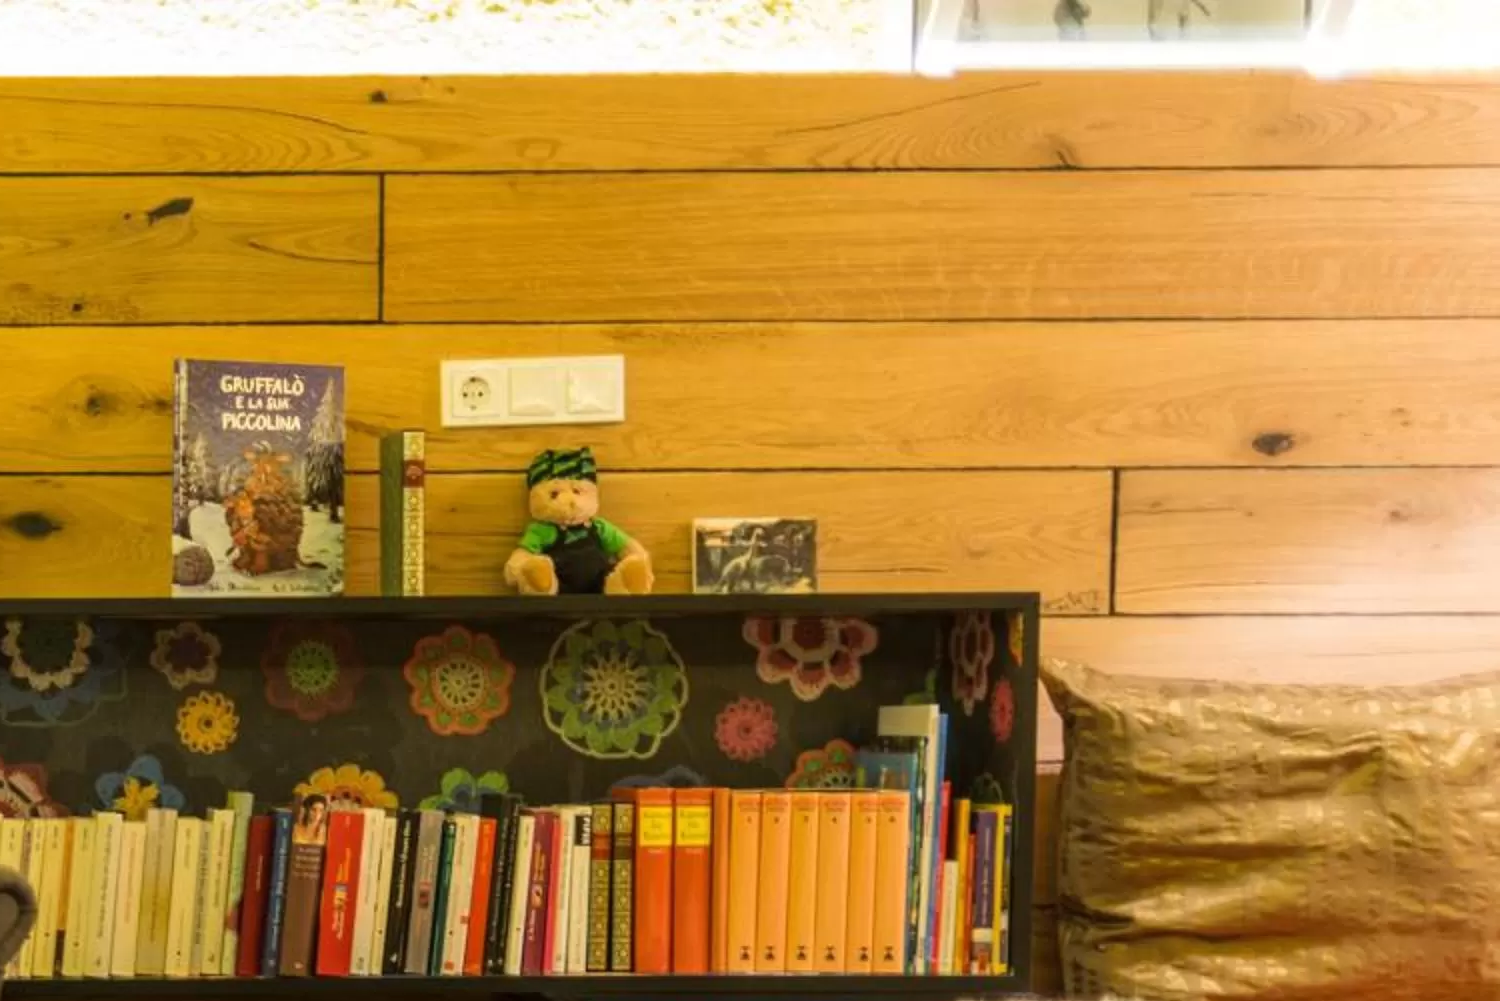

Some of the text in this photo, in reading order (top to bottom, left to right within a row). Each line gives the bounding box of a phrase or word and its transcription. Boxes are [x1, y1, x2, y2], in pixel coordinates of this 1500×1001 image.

[220, 374, 304, 396] GRUFFALÒ
[235, 396, 244, 409] E
[248, 398, 263, 409] LA
[221, 412, 301, 431] PICCOLINA
